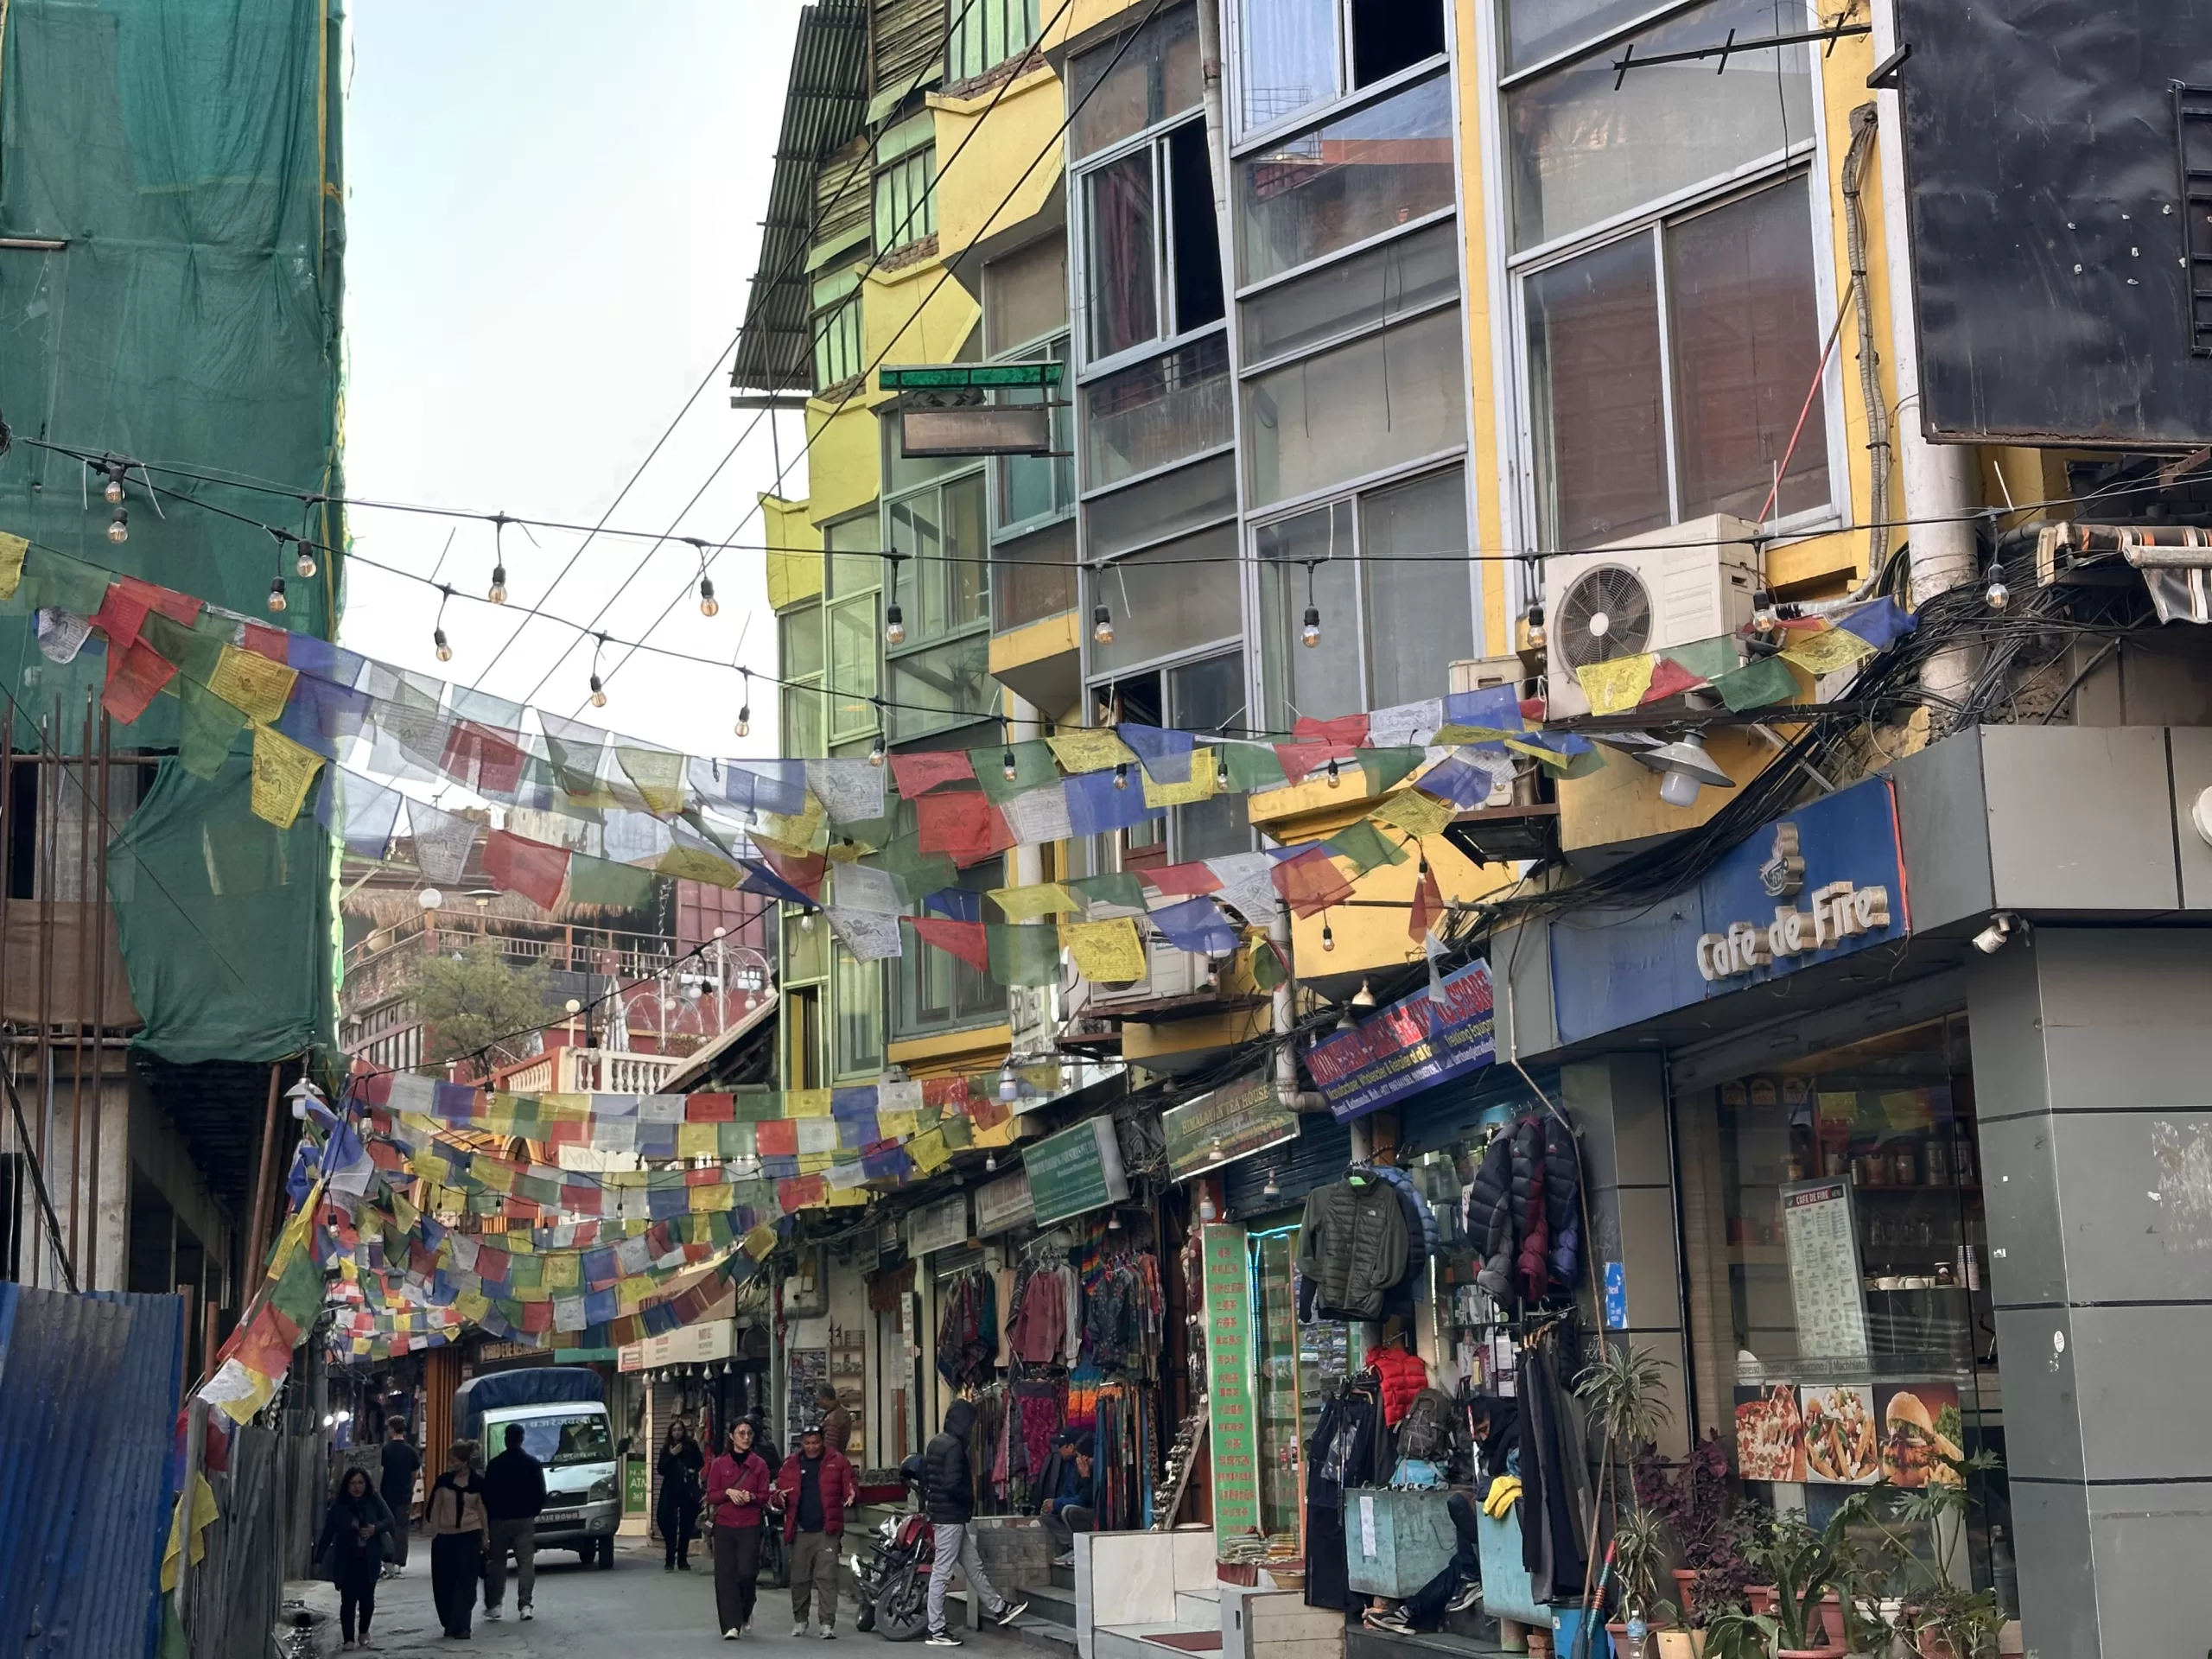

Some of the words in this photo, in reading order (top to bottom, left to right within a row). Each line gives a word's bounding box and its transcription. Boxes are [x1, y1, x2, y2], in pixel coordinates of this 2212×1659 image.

[1697, 921, 1770, 981] Cafe
[1769, 906, 1816, 957] de
[1812, 881, 1890, 949] Fire
[1226, 1096, 1241, 1116] TEA
[1242, 1085, 1269, 1108] HOUSE
